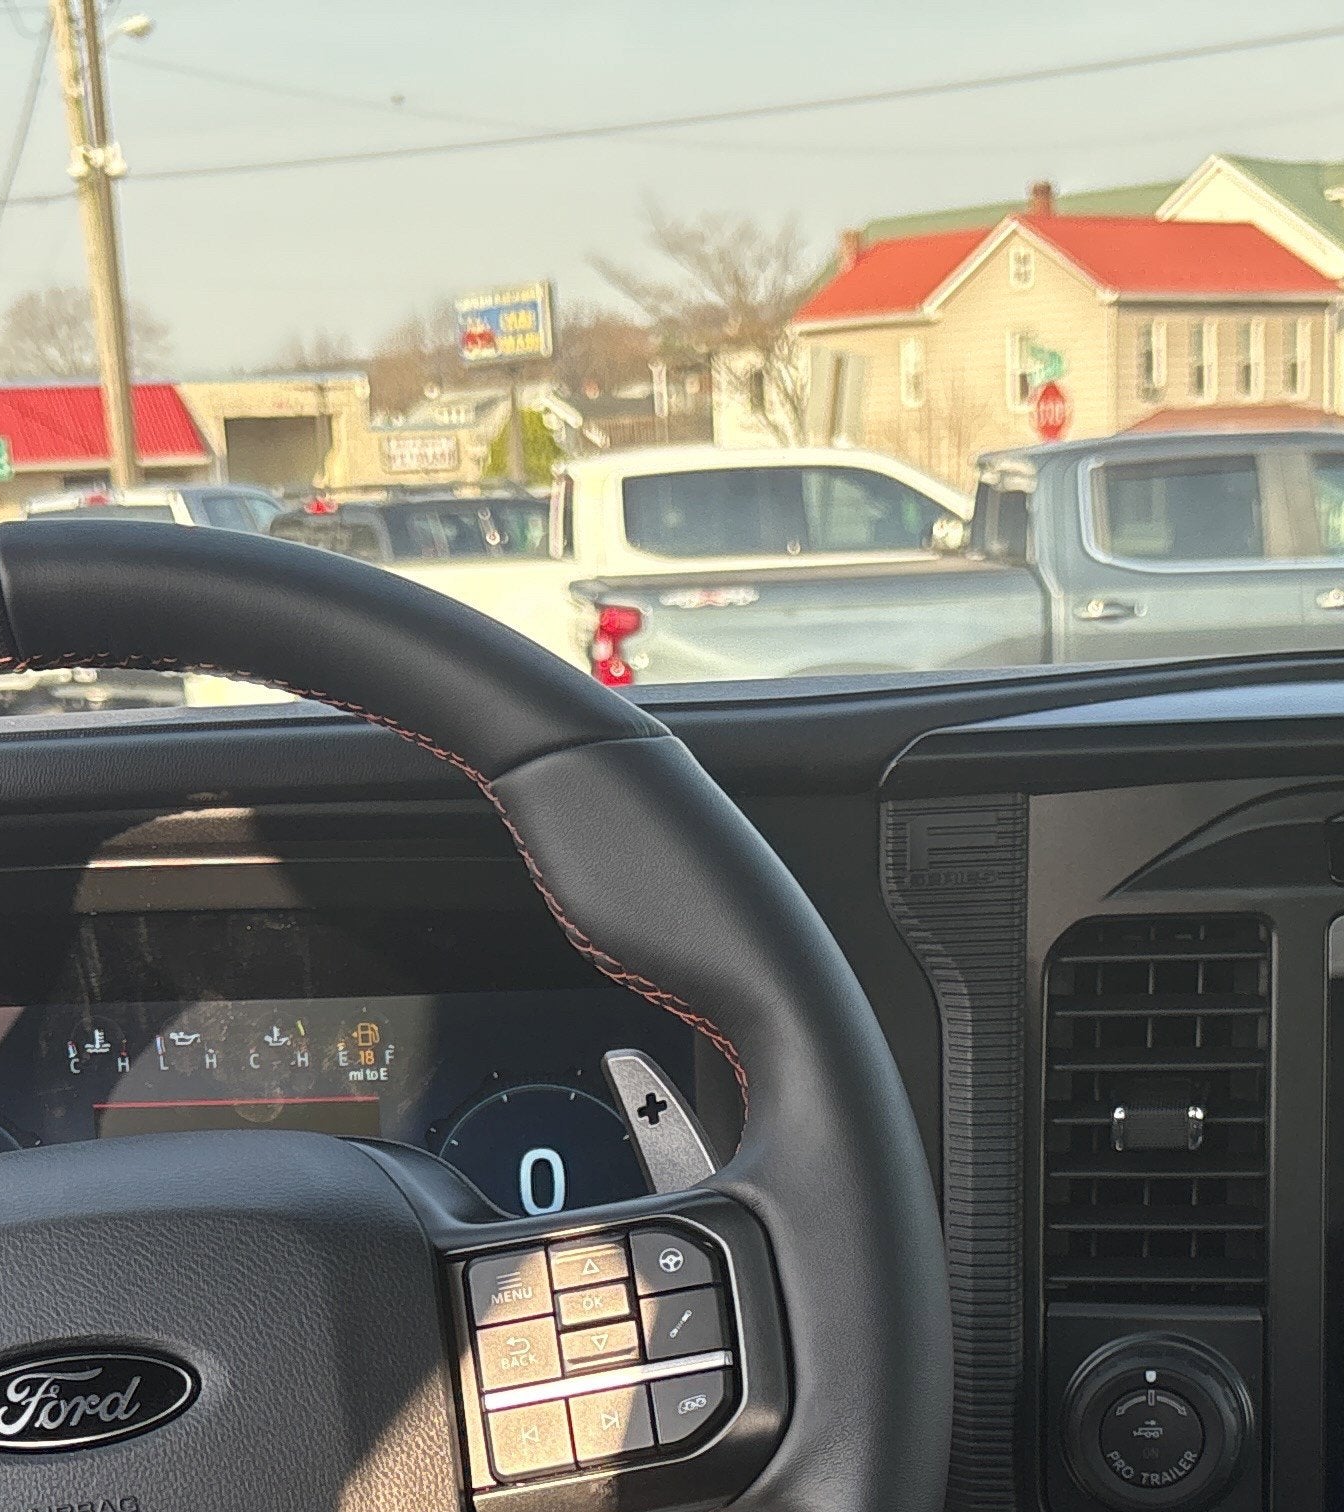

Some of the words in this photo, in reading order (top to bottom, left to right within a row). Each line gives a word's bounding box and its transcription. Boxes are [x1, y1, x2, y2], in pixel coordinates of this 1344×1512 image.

[118, 1056, 129, 1072] H
[160, 1056, 169, 1070] L
[206, 1054, 217, 1069] H
[250, 1053, 260, 1069] C
[298, 1053, 309, 1067] H
[339, 1051, 348, 1067] E
[359, 1050, 374, 1065] 18
[385, 1050, 394, 1065] F
[70, 1058, 80, 1074] C
[380, 1067, 389, 1080] E
[520, 1148, 565, 1215] 0
[491, 1288, 533, 1304] MENU
[501, 1353, 537, 1370] BACK
[1106, 1450, 1135, 1479] PRO
[1141, 1450, 1198, 1486] TRAILER
